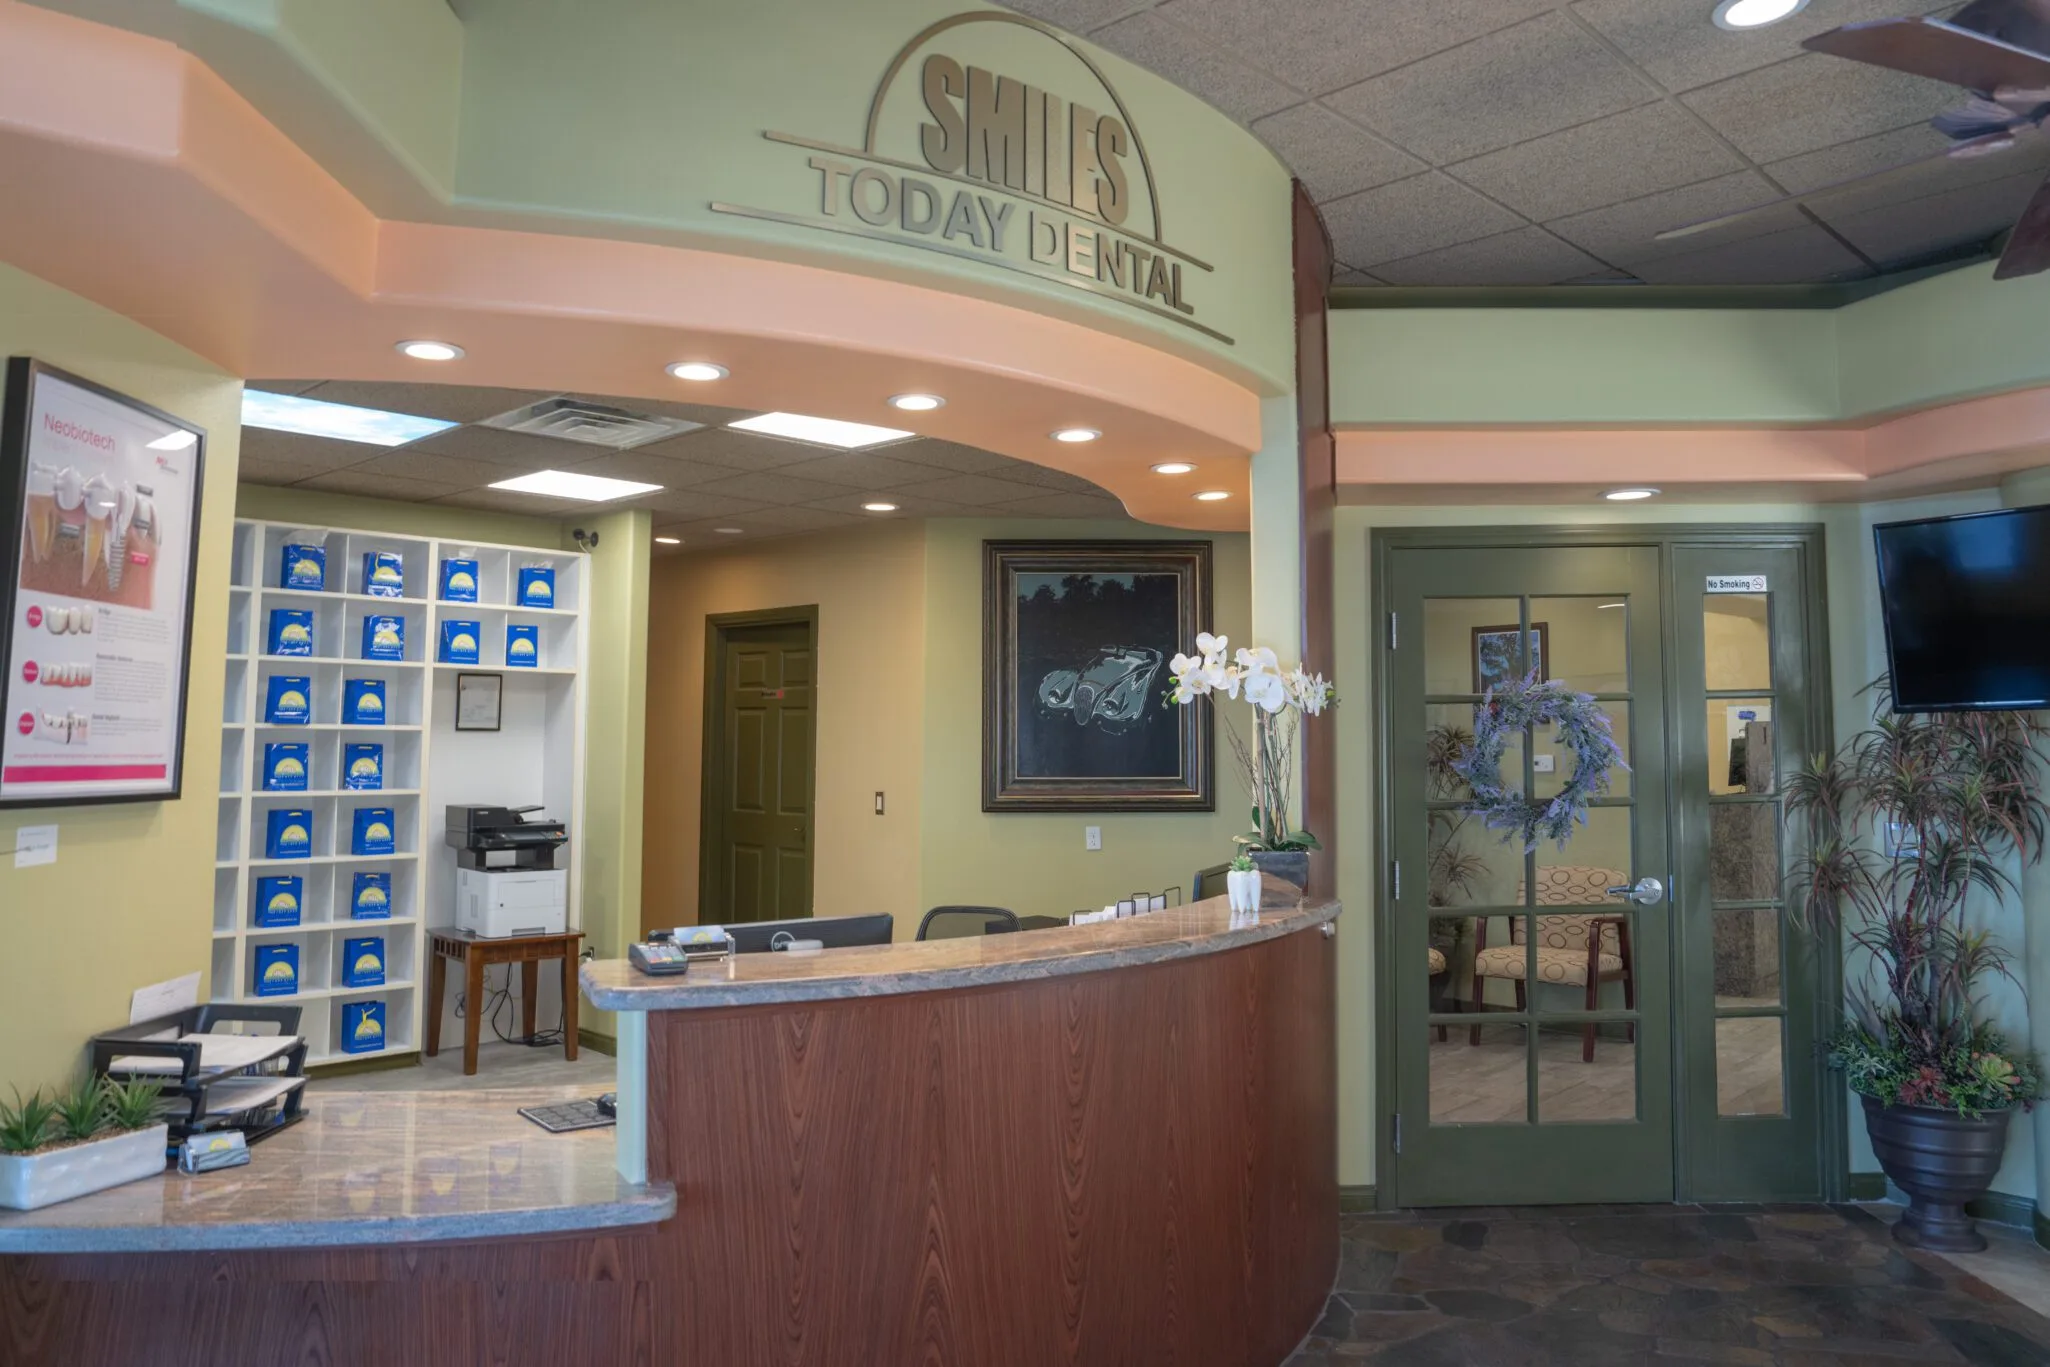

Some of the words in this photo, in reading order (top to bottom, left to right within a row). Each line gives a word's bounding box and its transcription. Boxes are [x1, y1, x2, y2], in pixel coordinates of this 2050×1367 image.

[921, 53, 1128, 226] SMILES
[809, 157, 1015, 252] TODAY
[1029, 211, 1195, 314] DENTAL
[44, 413, 115, 451] Neobiotech
[1708, 580, 1717, 589] No
[1720, 579, 1751, 590] Smoking
